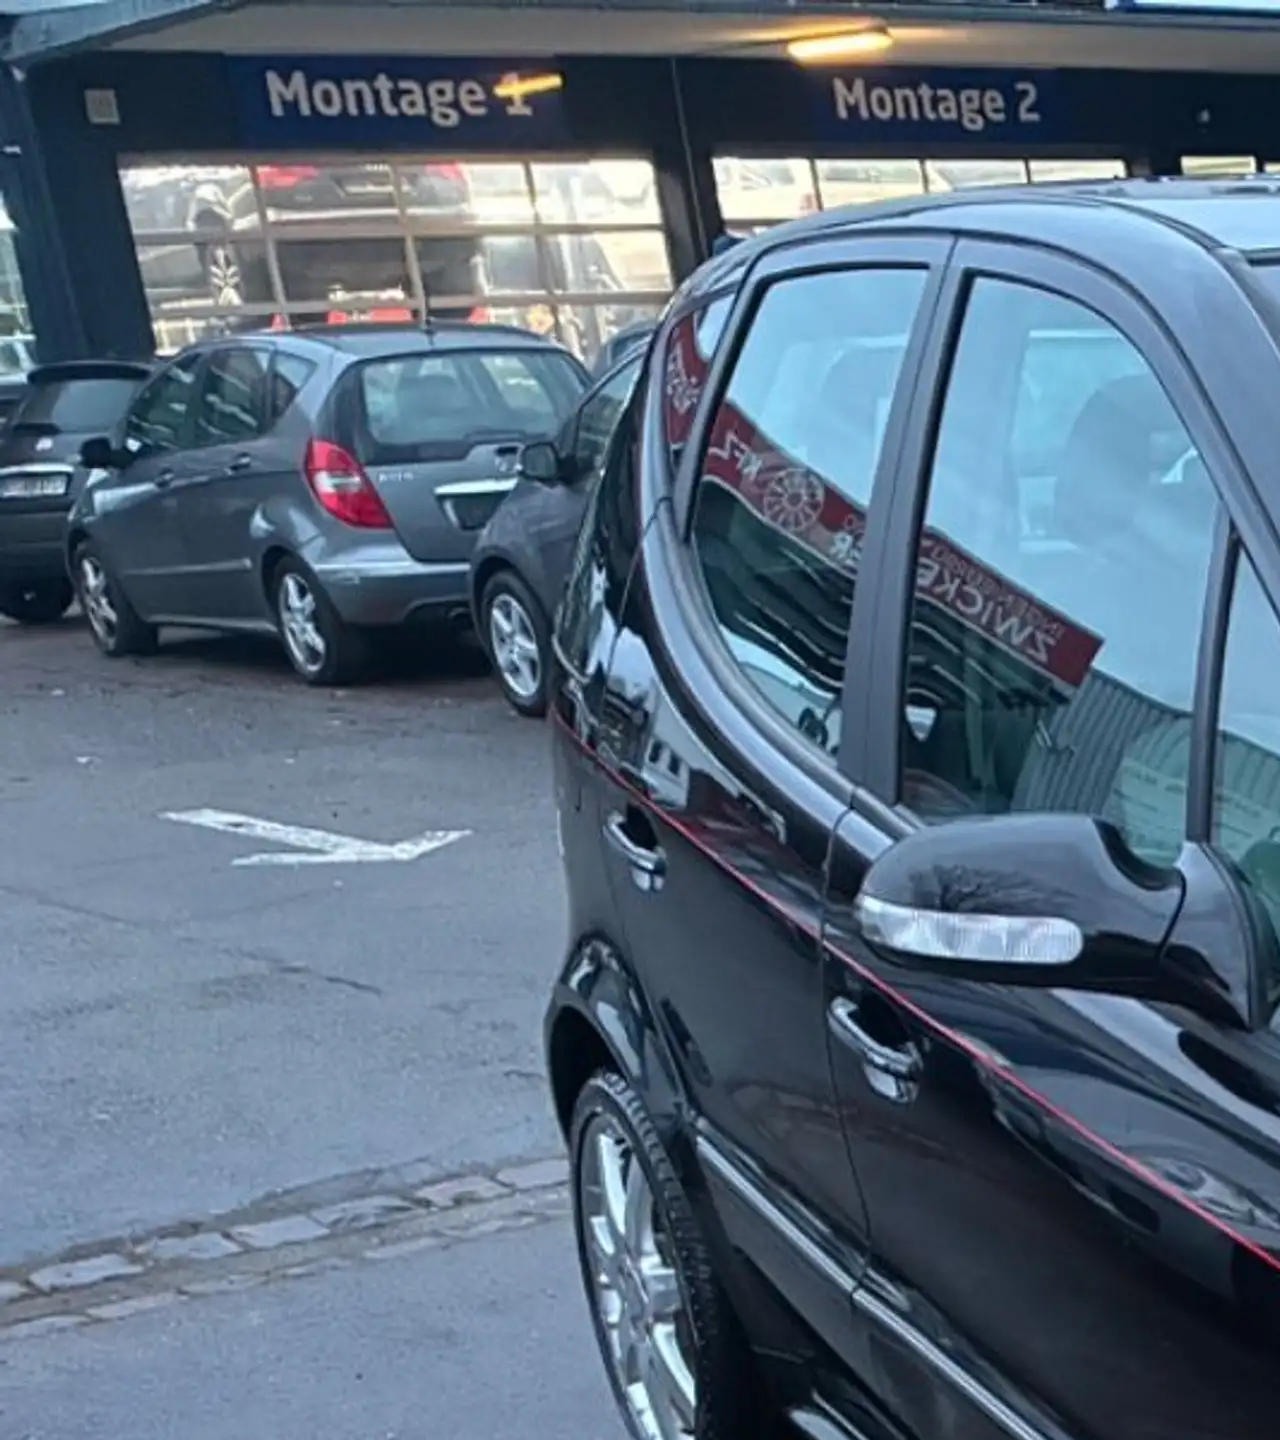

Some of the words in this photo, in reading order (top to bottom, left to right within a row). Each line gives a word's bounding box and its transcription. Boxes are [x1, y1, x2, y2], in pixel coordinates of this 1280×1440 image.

[265, 69, 488, 127] Montage
[833, 77, 1006, 131] Montage
[1014, 81, 1041, 122] 2
